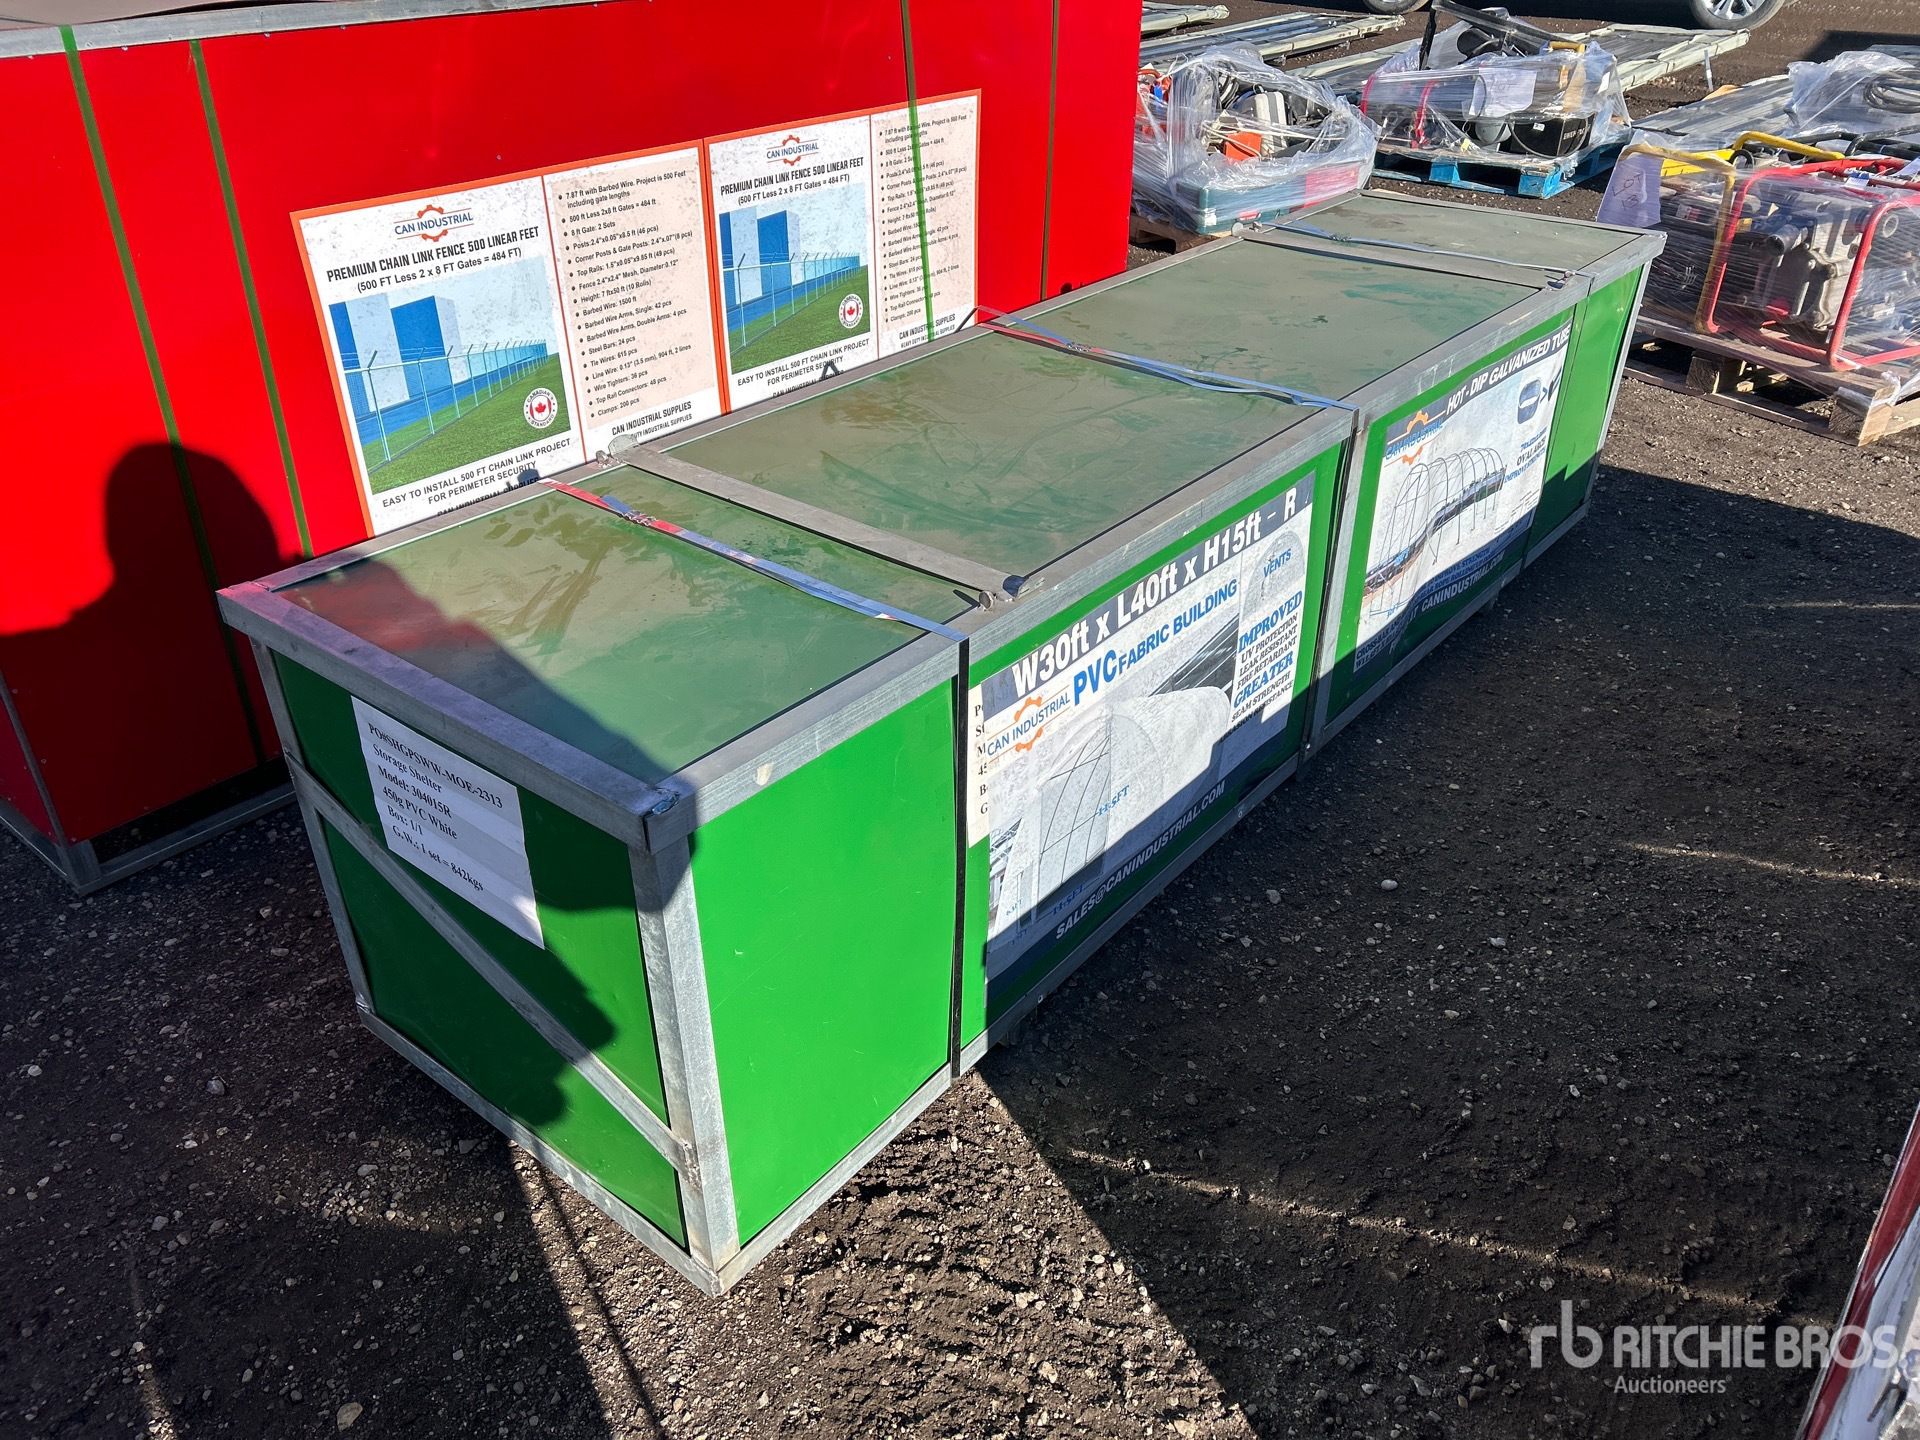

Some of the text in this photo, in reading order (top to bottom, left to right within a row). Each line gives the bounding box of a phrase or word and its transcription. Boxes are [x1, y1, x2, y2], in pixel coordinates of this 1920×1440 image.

[720, 156, 864, 196] PREMIUM CHAIN LINK FENCE 500 LINEAR FEET
[766, 142, 819, 159] CAN INDUSTRIAL
[738, 194, 751, 206] (500
[752, 192, 761, 201] FT
[762, 190, 777, 199] Less
[778, 187, 782, 195] 2
[789, 185, 793, 193] 8
[794, 182, 802, 192] FT
[803, 180, 821, 190] Gates
[828, 176, 838, 184] 484
[839, 173, 850, 182] FT)
[1612, 173, 1643, 196] LOT
[394, 212, 473, 235] CAN INDUSTRIAL
[326, 226, 538, 282] PREMIUM CHAIN LINK FENCE 500 LINEAR FEET
[357, 279, 377, 294] (500
[379, 275, 391, 286] FT
[394, 272, 417, 283] Less
[418, 268, 425, 278] 2
[435, 265, 441, 274] 8
[442, 262, 454, 273] FT
[457, 258, 482, 269] Gates
[491, 250, 506, 261] 484
[507, 247, 521, 258] FT)
[737, 338, 869, 386] EASY TO INSTALL 500 FT CHAIN LINK PROJECT
[767, 376, 780, 386] FOR
[781, 364, 814, 381] PERIMETER
[816, 356, 843, 369] SECURITY
[1446, 385, 1466, 415] HOT
[1470, 371, 1488, 396] DIP
[1489, 342, 1551, 385] GALVANIZED
[527, 390, 550, 402] CANADIAN
[531, 414, 554, 427] STANDARD
[611, 400, 691, 435] CAN INDUSTRIAL SUPPLIES
[643, 421, 670, 435] INDUSTRIAL
[670, 413, 692, 426] SUPPLIES
[382, 437, 570, 507] EASY TO INSTALL 500 FT CHAIN LINK PROJECT
[428, 492, 446, 504] FOR
[448, 474, 495, 497] PERIMETER
[497, 461, 536, 480] SECURITY
[1263, 548, 1291, 578] VENTS
[1011, 619, 1089, 698] W30ft
[1095, 611, 1110, 644] x
[1117, 562, 1178, 629] L40ft
[1183, 555, 1199, 586] x
[1203, 511, 1261, 572] H15ft
[1284, 487, 1297, 522] R
[1073, 578, 1237, 706] PVC FABRIC BUILDING
[1238, 591, 1303, 653] IMPROVED
[1241, 612, 1298, 664] UV PROTECTION
[1236, 636, 1297, 690] FIRE RETARDANT
[1239, 624, 1297, 678] LEAK RESISTANT
[1231, 670, 1291, 722] SEAM STRENGTH
[1233, 650, 1294, 709] GREATER
[987, 692, 1070, 756] CAN INDUSTRIAL
[368, 722, 502, 808] PO#SHGPSWW-MOE-2313
[372, 743, 441, 792] Storage Shelter
[377, 764, 452, 818] Model: 304015R
[382, 786, 457, 839] 450g PVC White
[387, 804, 423, 835] Box: 1/1
[392, 825, 419, 849] G.W.:
[421, 843, 426, 853] 1
[428, 850, 441, 863] set
[450, 862, 483, 891] 842kgs
[1056, 779, 1226, 940] SALES@CANINDUSTRIAL.COM
